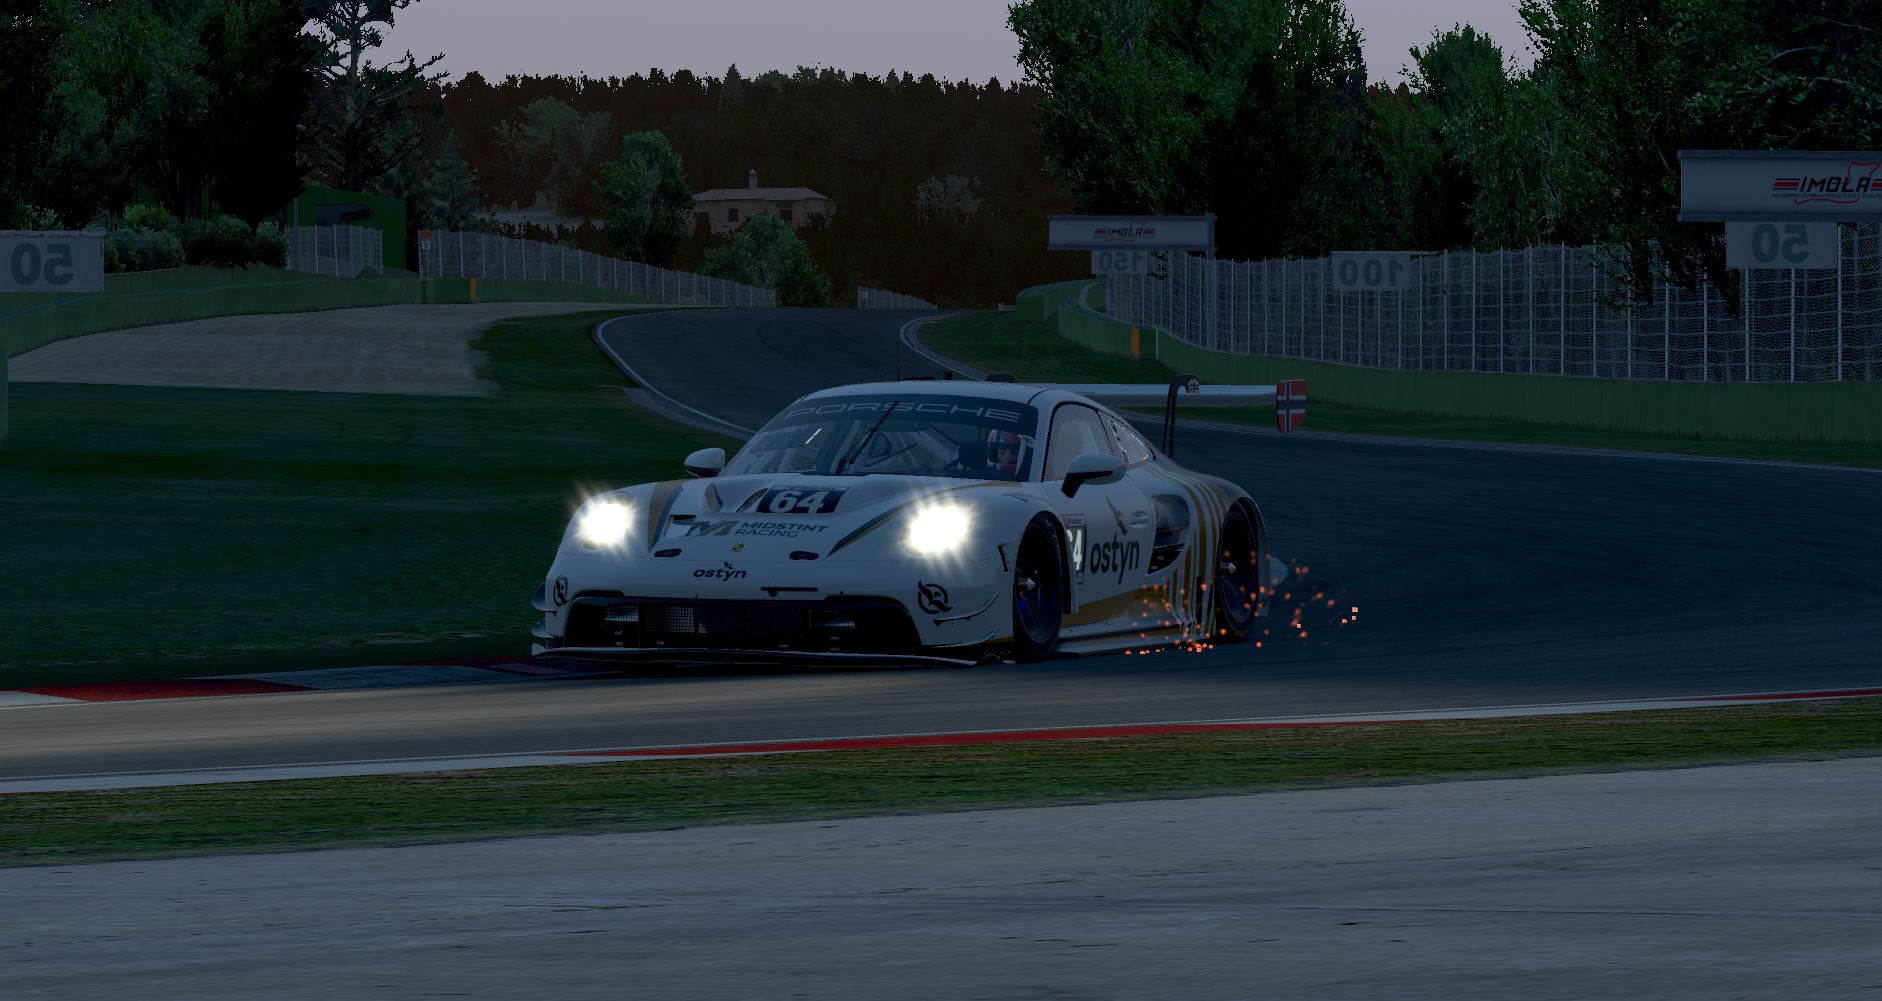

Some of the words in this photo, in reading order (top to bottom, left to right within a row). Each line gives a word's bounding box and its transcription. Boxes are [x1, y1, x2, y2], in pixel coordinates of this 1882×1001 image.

[1800, 176, 1871, 193] IMOLA
[1107, 226, 1143, 236] IMOLA
[784, 402, 1021, 424] PORSCHE
[768, 490, 829, 514] 64
[734, 528, 801, 538] RACING
[740, 522, 829, 533] MIDSTINT
[1090, 531, 1140, 585] ostyn
[693, 566, 747, 582] ostyn
